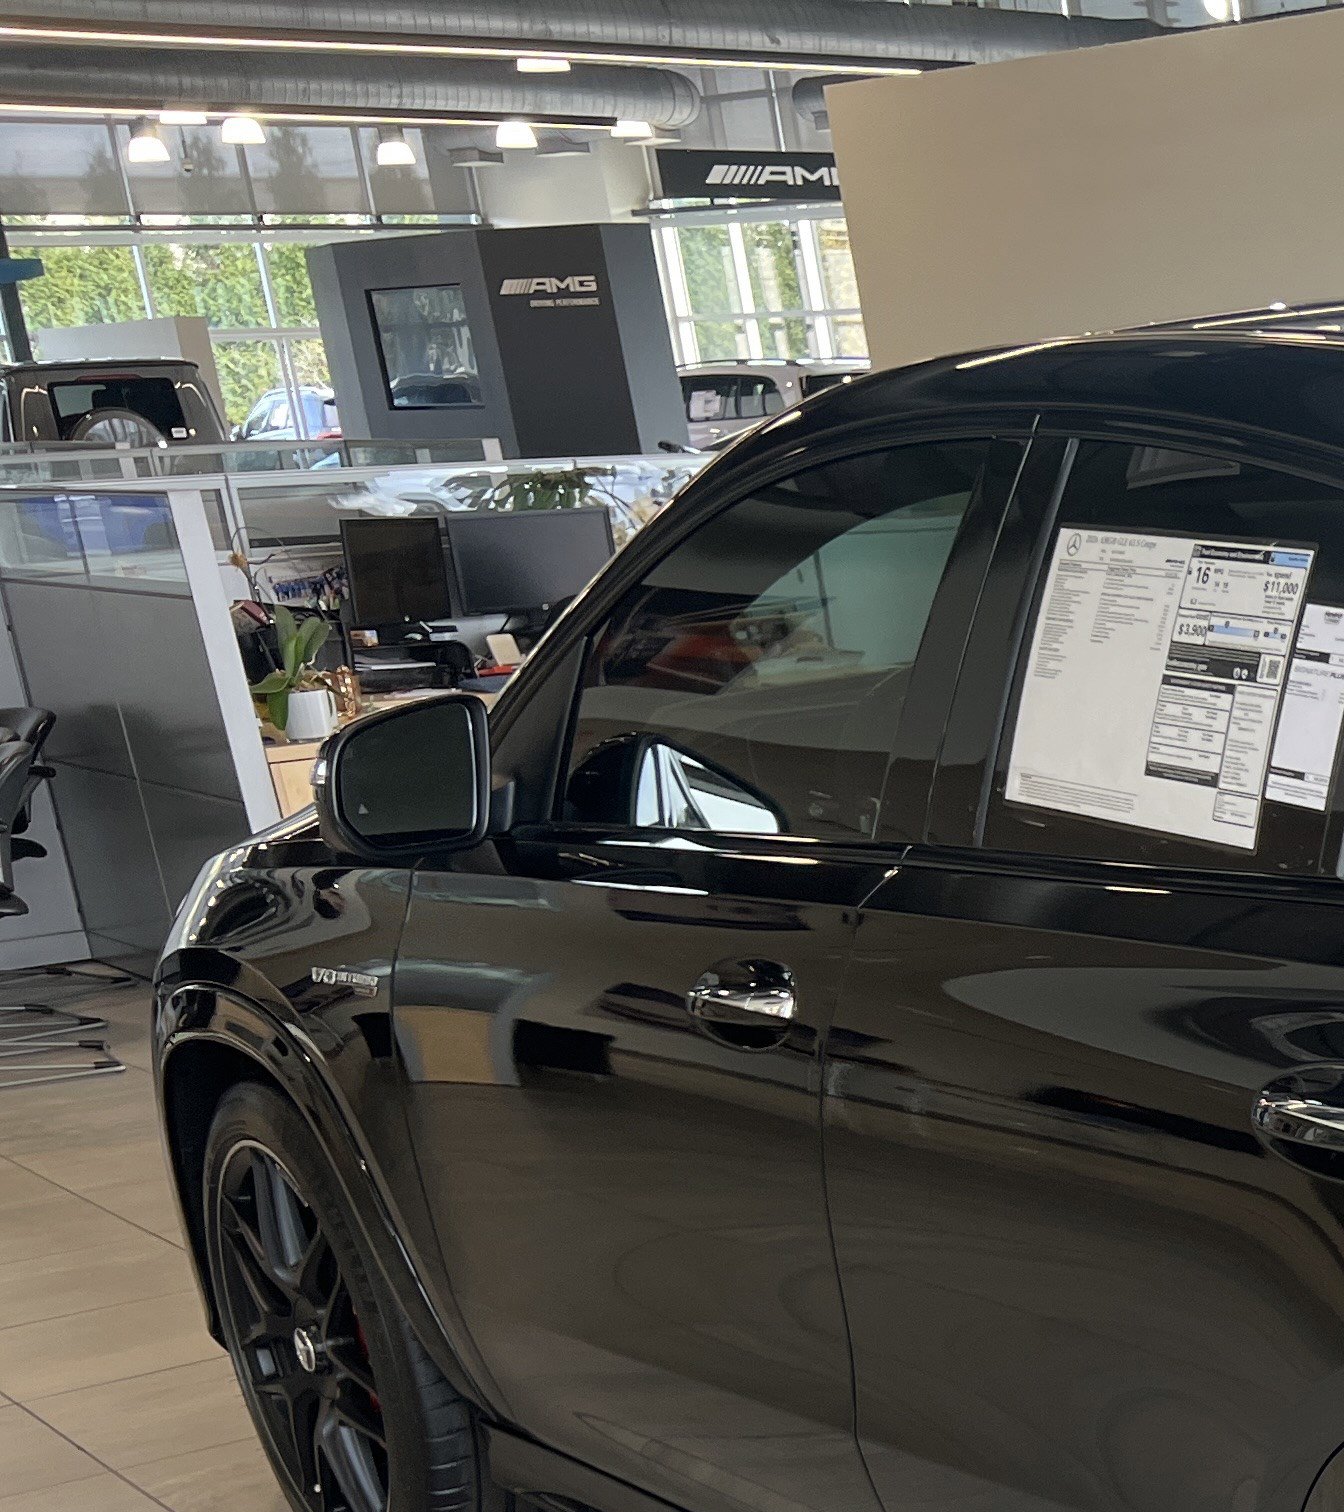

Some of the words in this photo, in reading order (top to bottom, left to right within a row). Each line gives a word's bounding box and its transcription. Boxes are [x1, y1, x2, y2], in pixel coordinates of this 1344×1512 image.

[1196, 566, 1211, 585] 16
[1263, 580, 1299, 596] $11,000
[1178, 623, 1208, 637] $3,900
